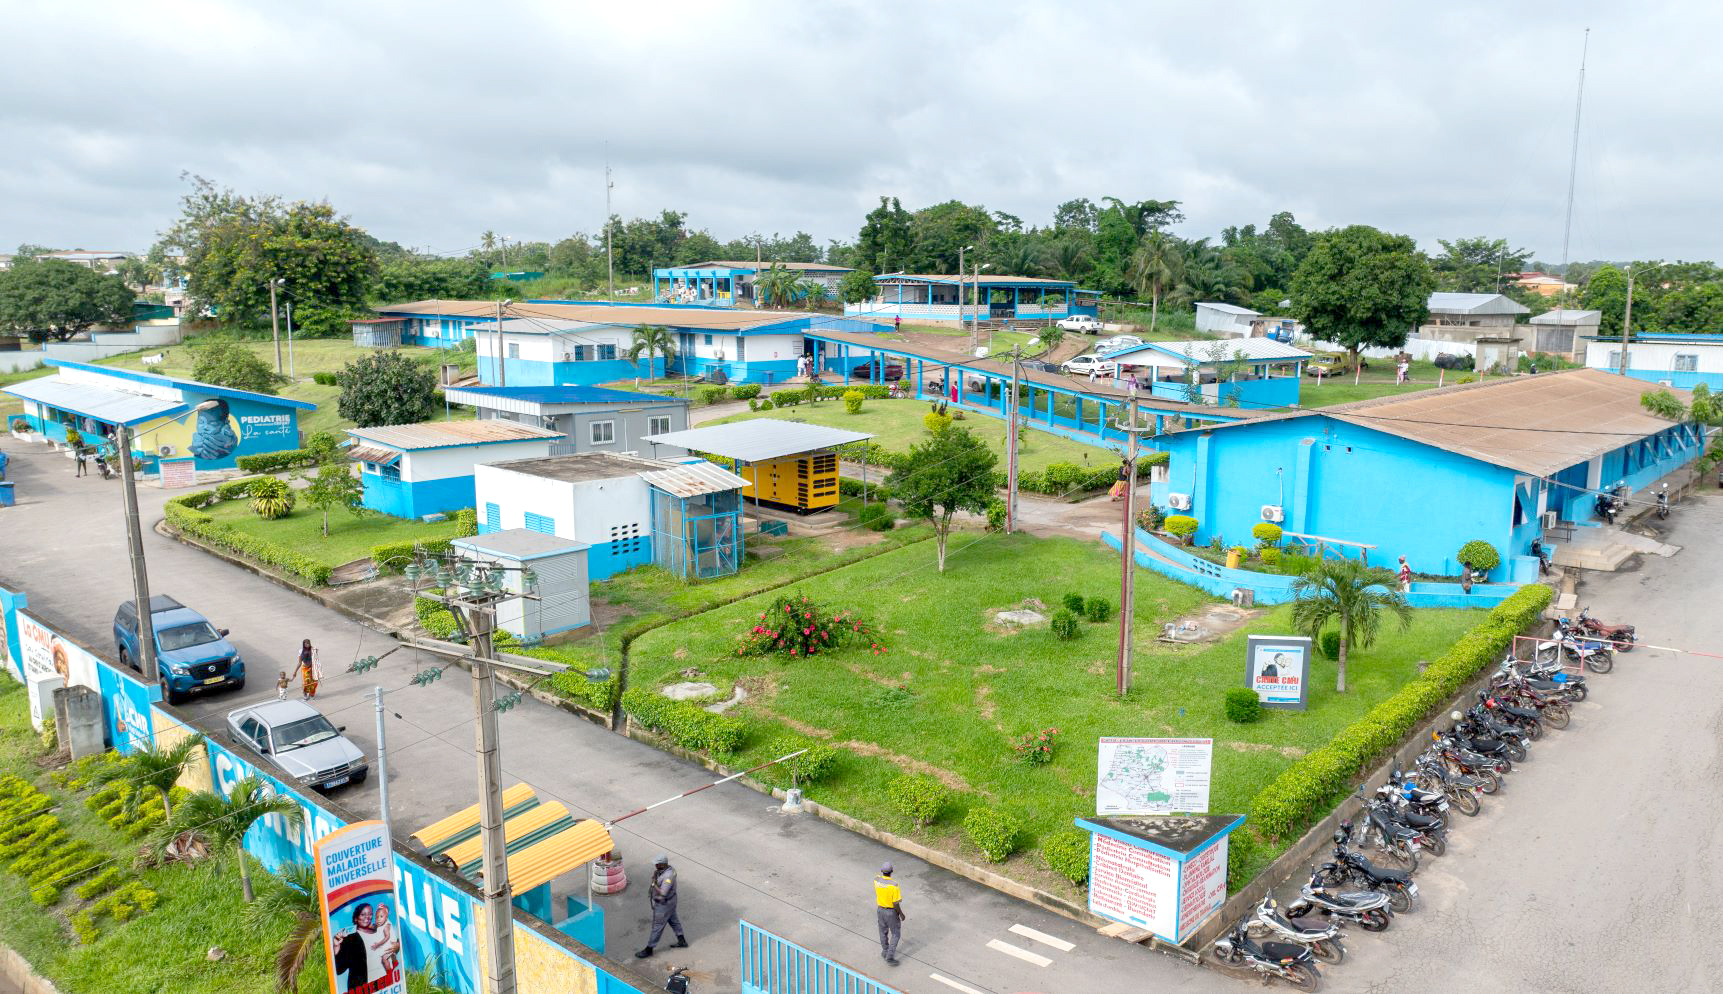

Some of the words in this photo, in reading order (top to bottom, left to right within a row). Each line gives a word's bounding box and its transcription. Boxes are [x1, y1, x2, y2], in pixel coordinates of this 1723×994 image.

[241, 415, 291, 424] PEDIATRIE
[1281, 677, 1299, 685] CMU
[325, 836, 383, 866] COUVERTURE
[327, 853, 368, 878] MALADIE
[328, 857, 388, 888] UNIVERSELLE
